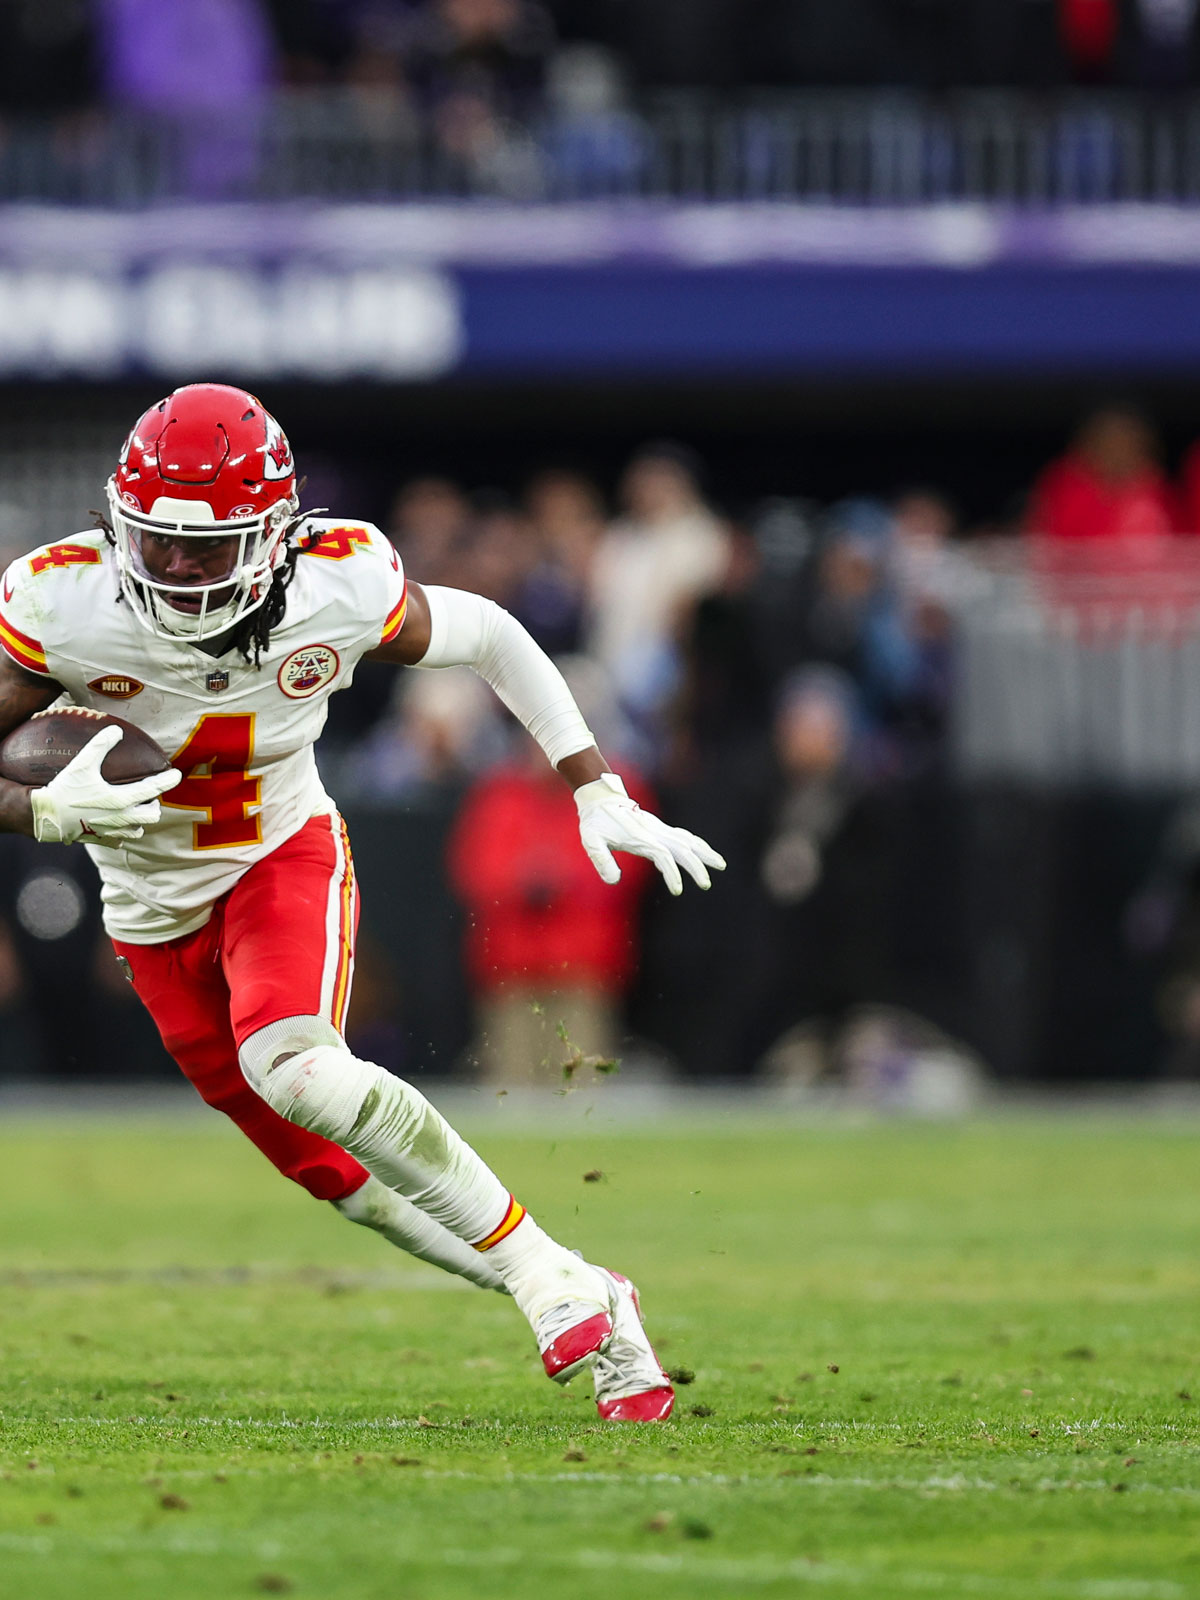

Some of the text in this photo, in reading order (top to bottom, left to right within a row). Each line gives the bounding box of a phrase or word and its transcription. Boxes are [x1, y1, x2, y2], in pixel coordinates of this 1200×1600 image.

[29, 543, 102, 576] 4
[297, 526, 373, 561] 4
[102, 681, 130, 692] NKH
[32, 748, 72, 757] FOOTBALL
[159, 712, 263, 851] 4
